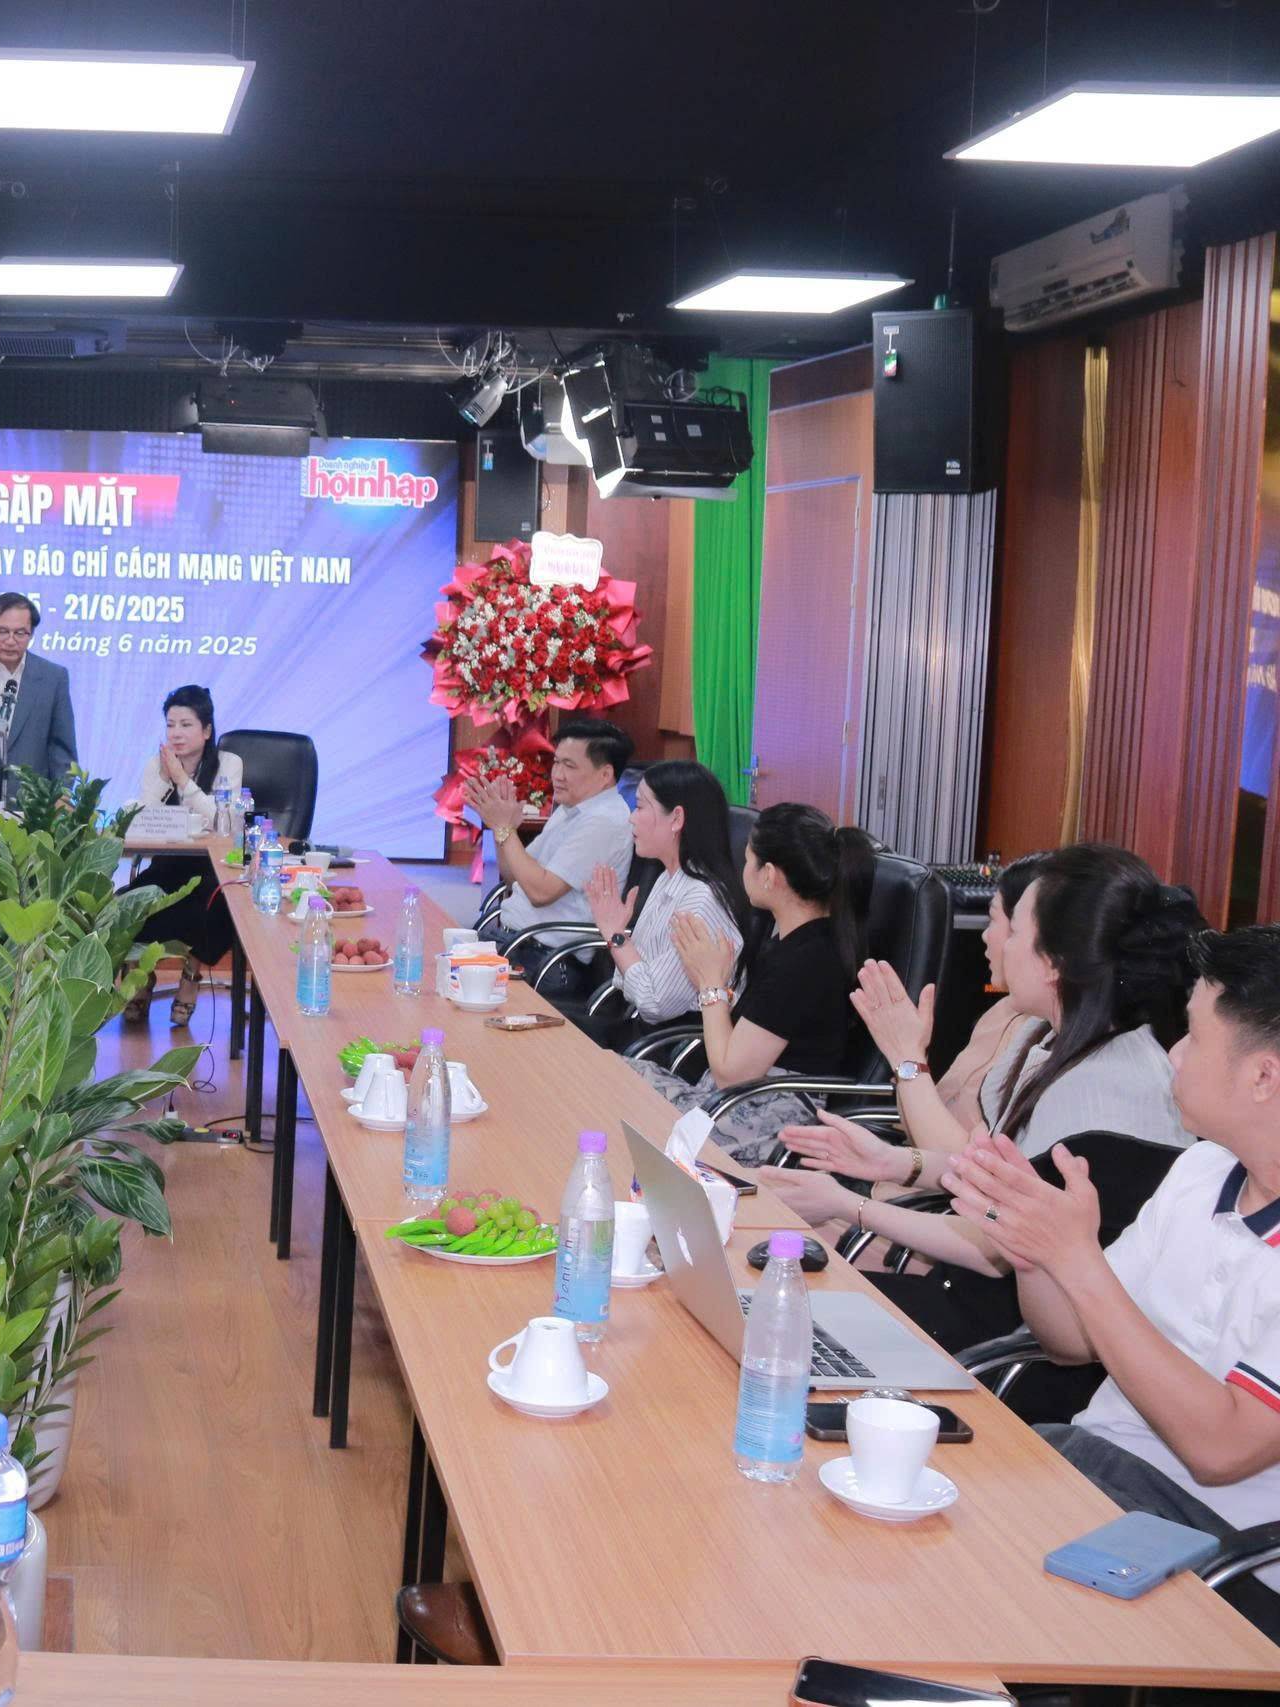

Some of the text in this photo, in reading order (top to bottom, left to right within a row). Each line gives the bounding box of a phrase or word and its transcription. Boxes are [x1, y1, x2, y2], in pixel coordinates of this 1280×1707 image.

[63, 476, 137, 536] MẶT
[23, 543, 65, 577] BÁO
[72, 545, 107, 578] CHÍ
[114, 546, 170, 580] CÁCH
[178, 552, 243, 586] MẠNG
[250, 549, 294, 588] VIỆT
[301, 556, 351, 584] NAM
[64, 593, 185, 623] 21/6/2025
[41, 630, 111, 655] tháng
[119, 633, 133, 653] 6
[139, 632, 192, 654] năm
[199, 635, 258, 656] 2025
